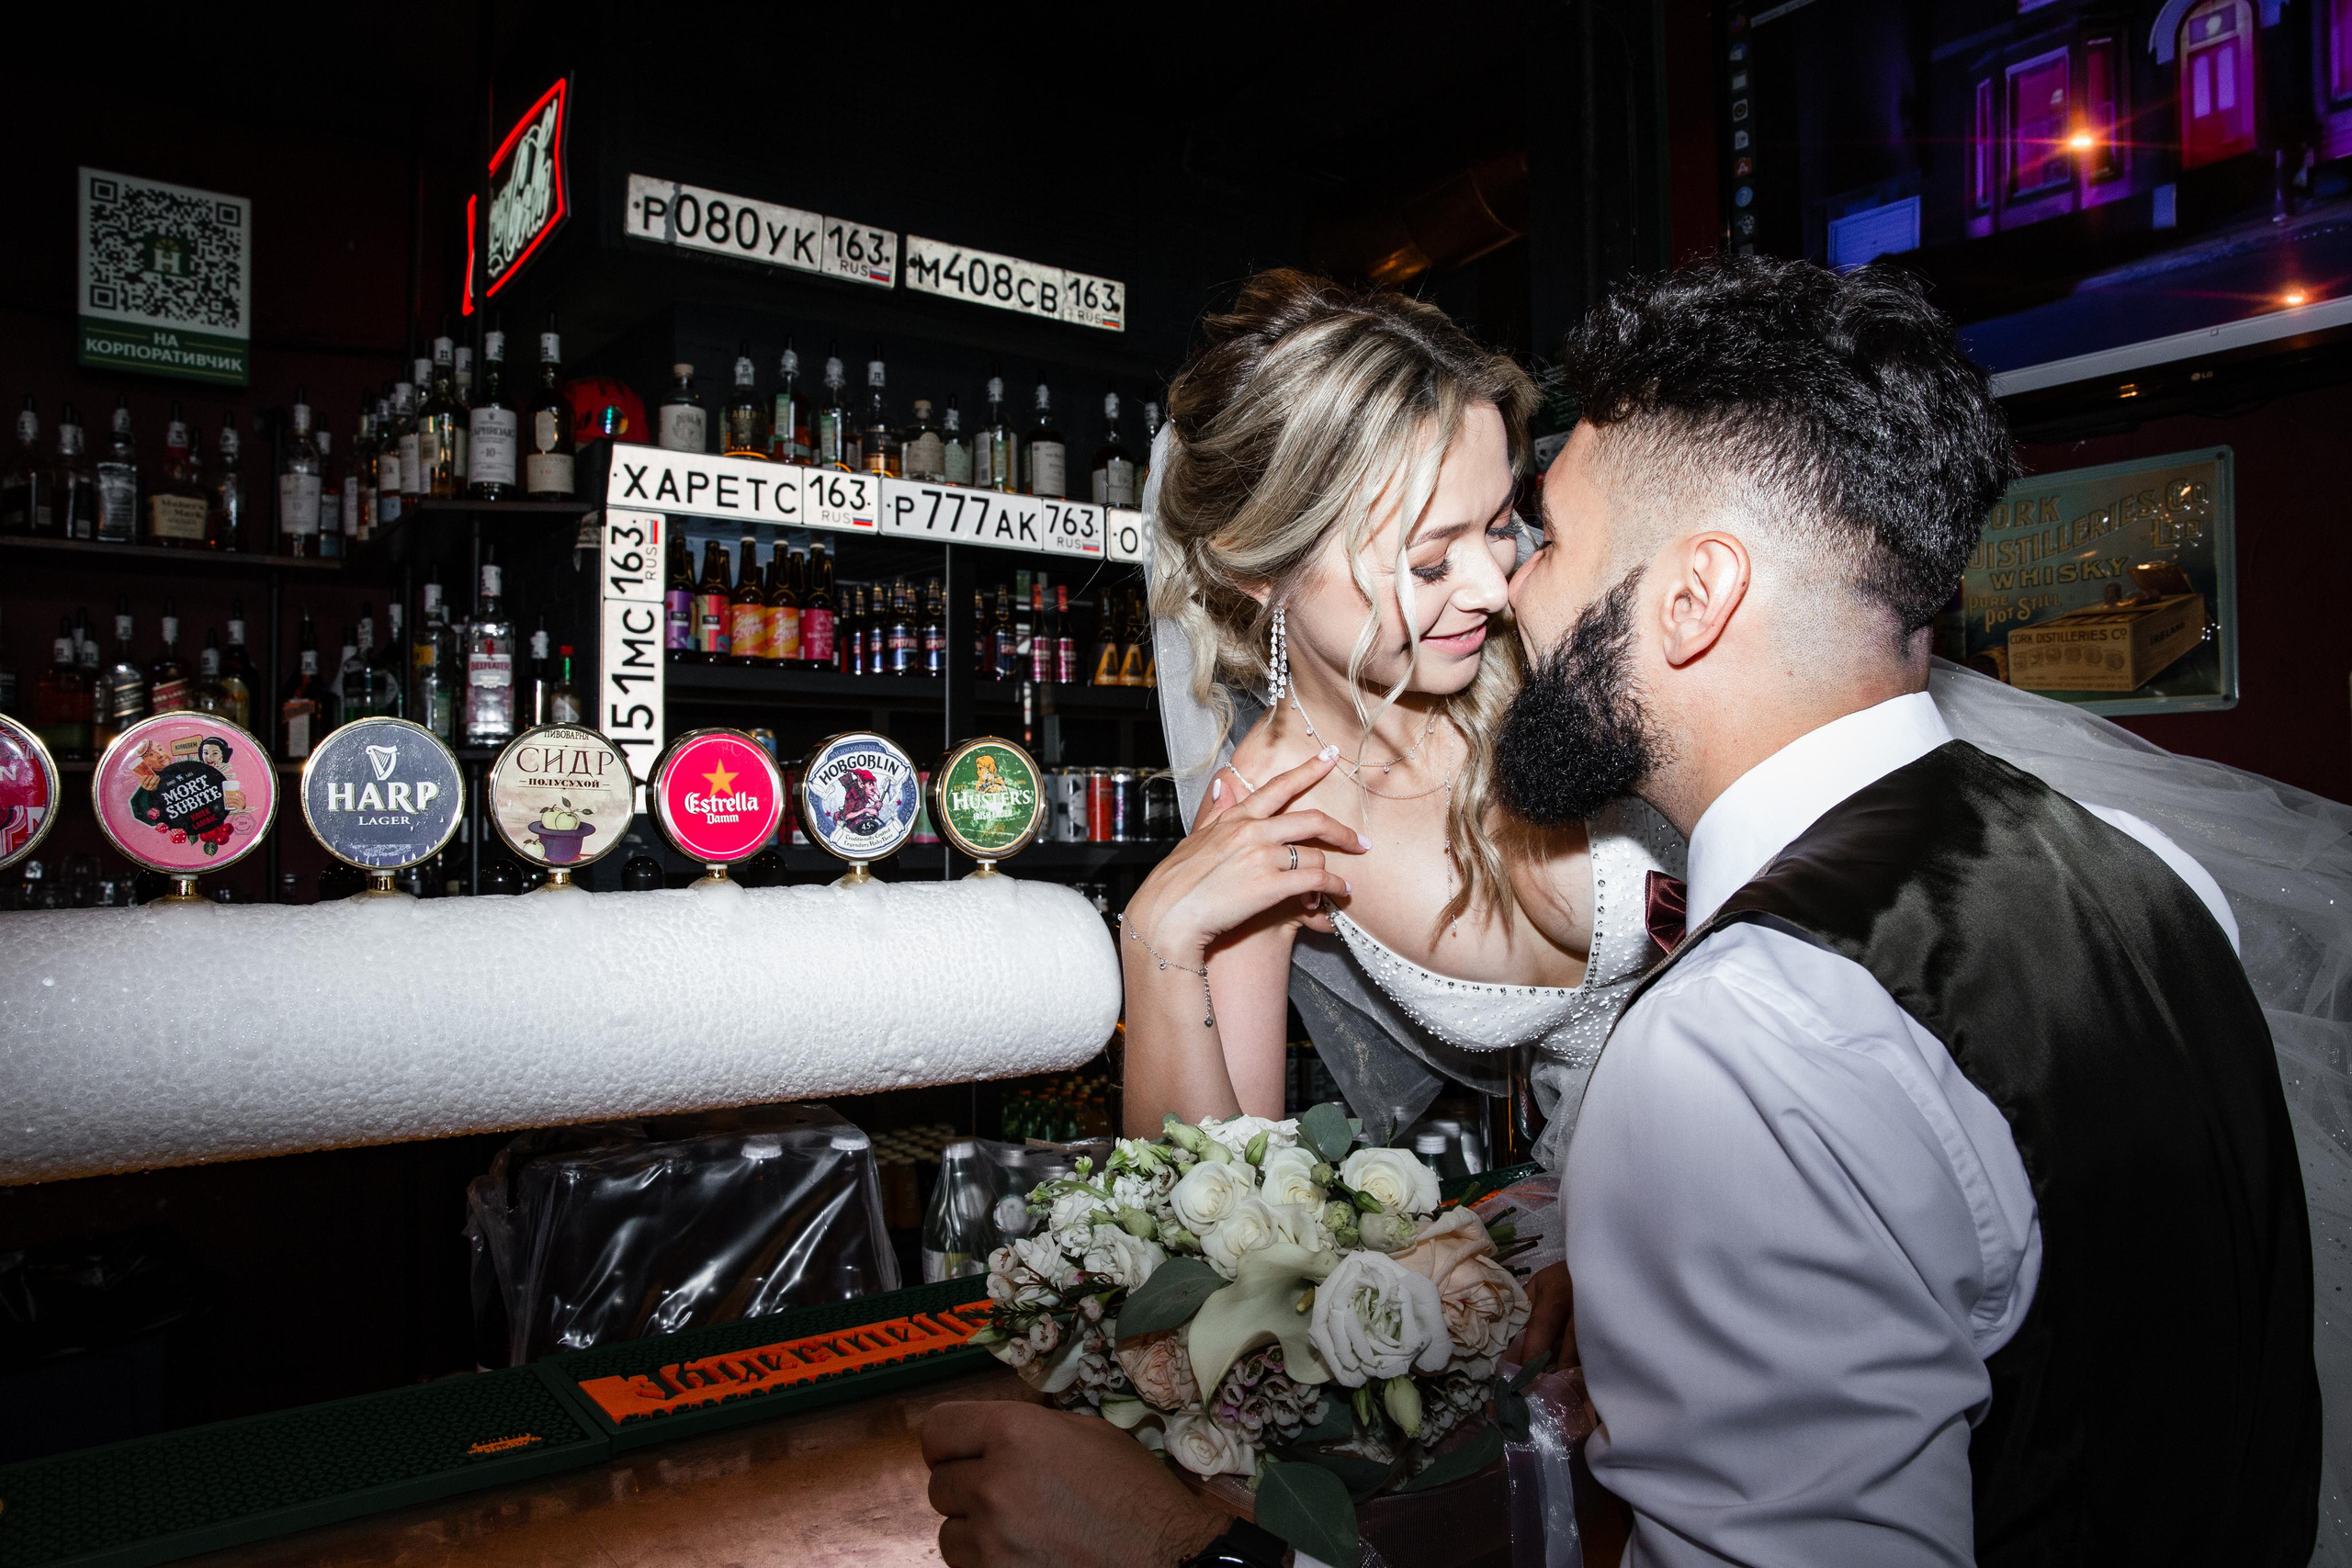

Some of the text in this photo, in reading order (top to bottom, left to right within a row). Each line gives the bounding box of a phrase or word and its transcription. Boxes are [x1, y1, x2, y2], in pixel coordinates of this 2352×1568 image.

[827, 225, 884, 265] 163
[839, 260, 868, 277] RUS
[1068, 278, 1116, 311] 163
[1078, 310, 1102, 323] RUS
[85, 337, 243, 371] КОРПОРАТИВЧИК
[153, 332, 179, 347] НА
[808, 475, 865, 511] 163
[820, 510, 852, 525] RUS
[1046, 504, 1094, 538] 763
[1990, 494, 2063, 531] ORK
[1057, 536, 1081, 549] RUS
[610, 525, 644, 594] 163
[645, 546, 657, 581] RUS
[1990, 555, 2131, 592] WHISKY
[2009, 631, 2033, 645] CORK
[2036, 629, 2108, 644] DISTILLERIES
[544, 729, 590, 740] ПИВОВАРНЯ
[516, 747, 615, 778] СИДР
[819, 754, 900, 785] HOBGOBLIN
[161, 774, 209, 805] MORT
[327, 782, 440, 815] HARP
[528, 778, 600, 788] ПОЛУСУХОЙ
[165, 785, 222, 819] SUBITE
[684, 791, 760, 815] Estrella
[973, 811, 991, 821] IRISH
[358, 816, 411, 826] LAGER
[706, 813, 740, 825] Damm
